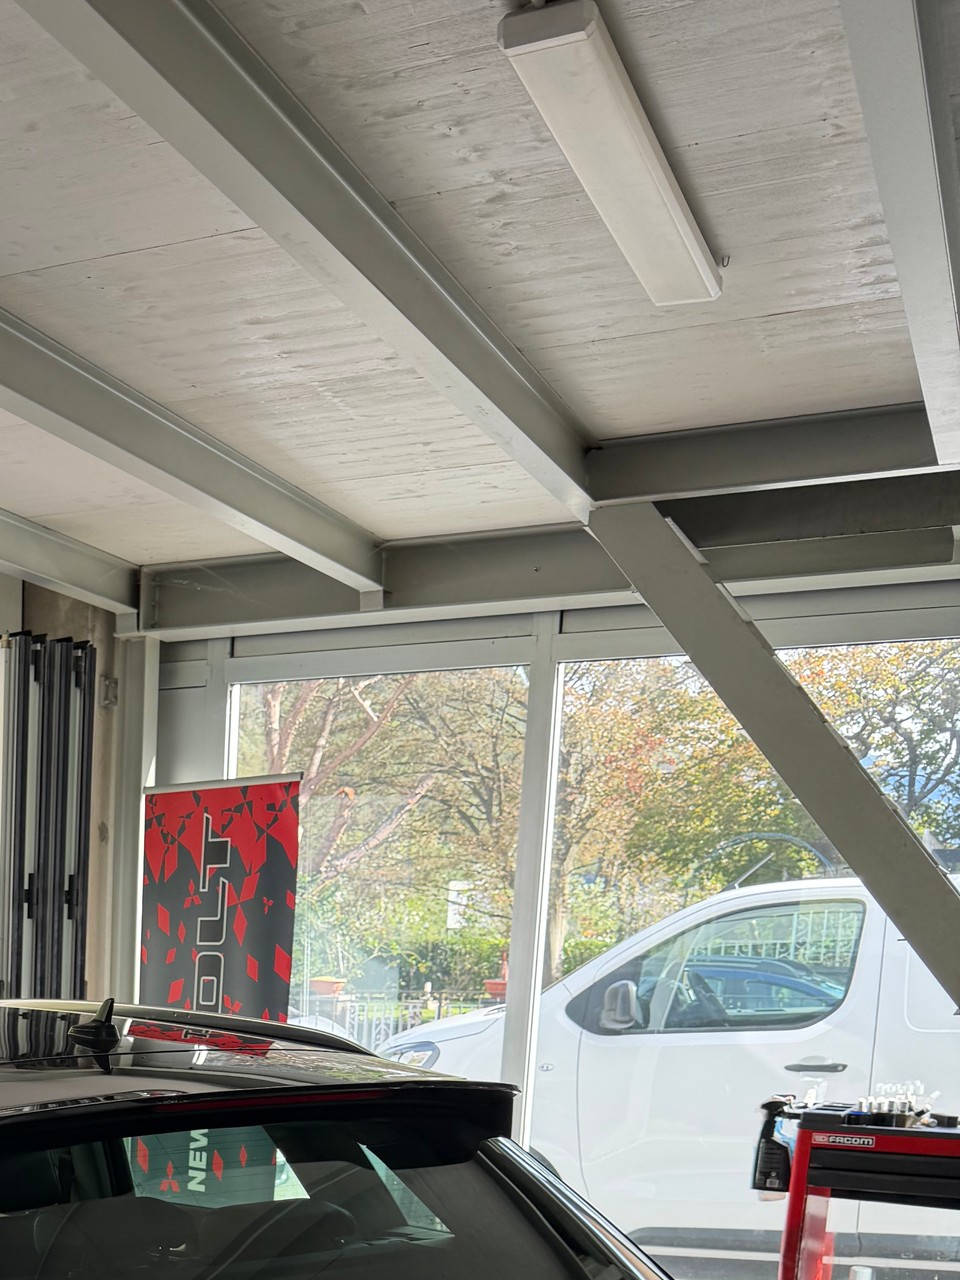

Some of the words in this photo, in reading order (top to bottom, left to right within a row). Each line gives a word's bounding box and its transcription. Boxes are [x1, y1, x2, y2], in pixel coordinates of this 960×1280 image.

[193, 812, 231, 1013] OLT
[187, 1128, 209, 1193] NEW
[828, 1135, 873, 1146] FACOM
